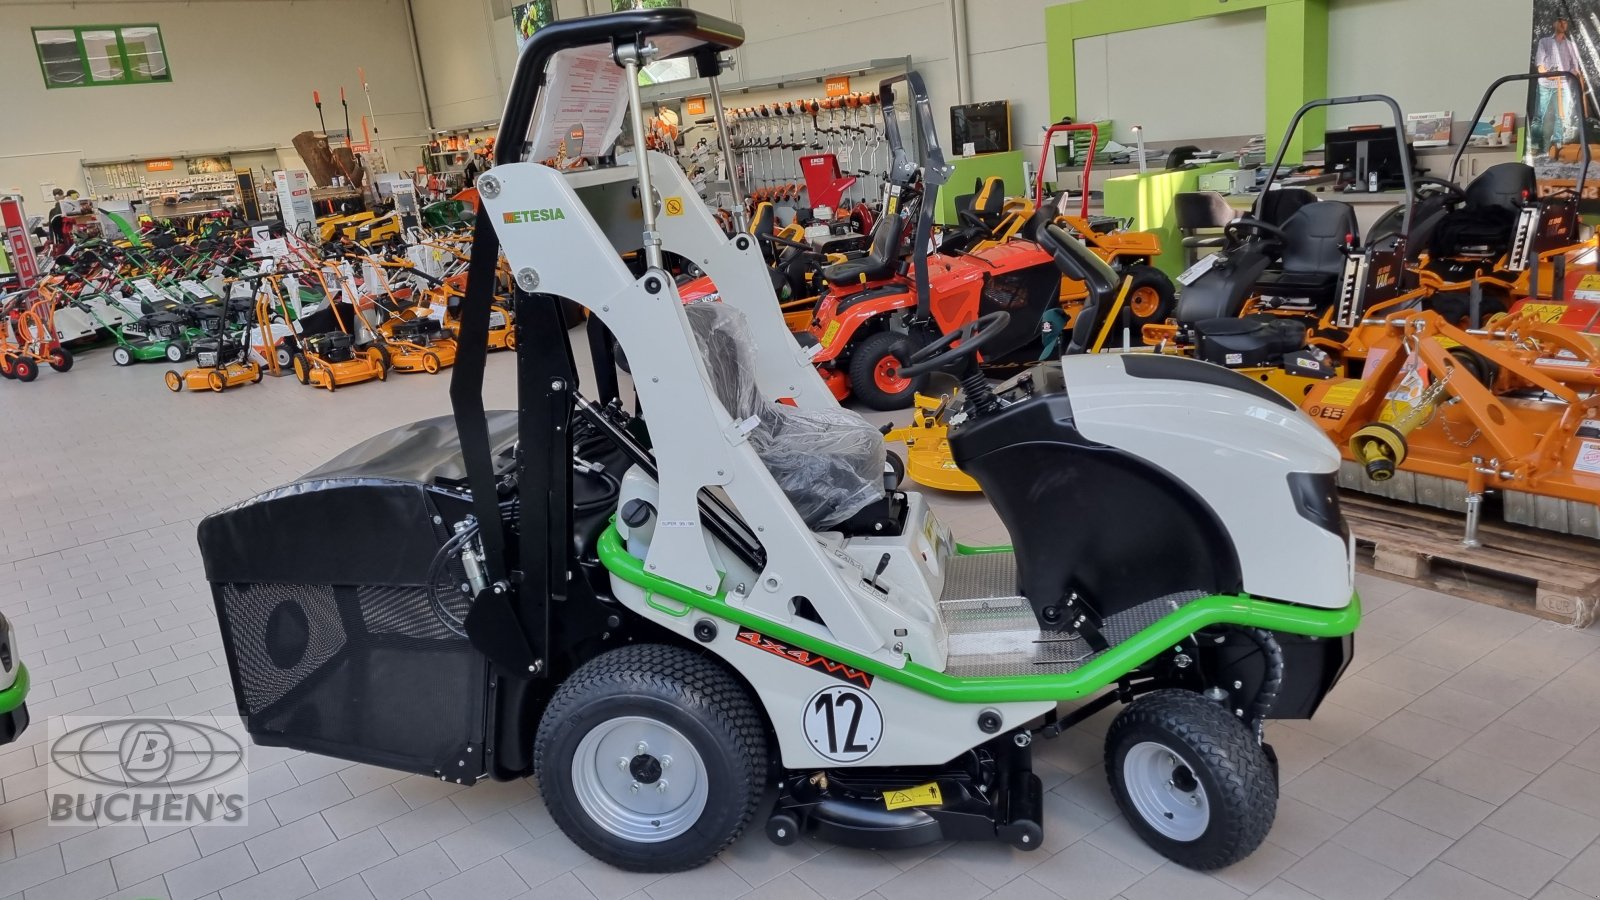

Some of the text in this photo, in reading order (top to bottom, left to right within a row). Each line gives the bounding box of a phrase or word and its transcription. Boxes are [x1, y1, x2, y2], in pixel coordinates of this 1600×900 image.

[827, 82, 845, 91] STIHL
[688, 102, 702, 110] STIHL
[512, 207, 565, 224] ETESIA
[814, 693, 868, 753] 12
